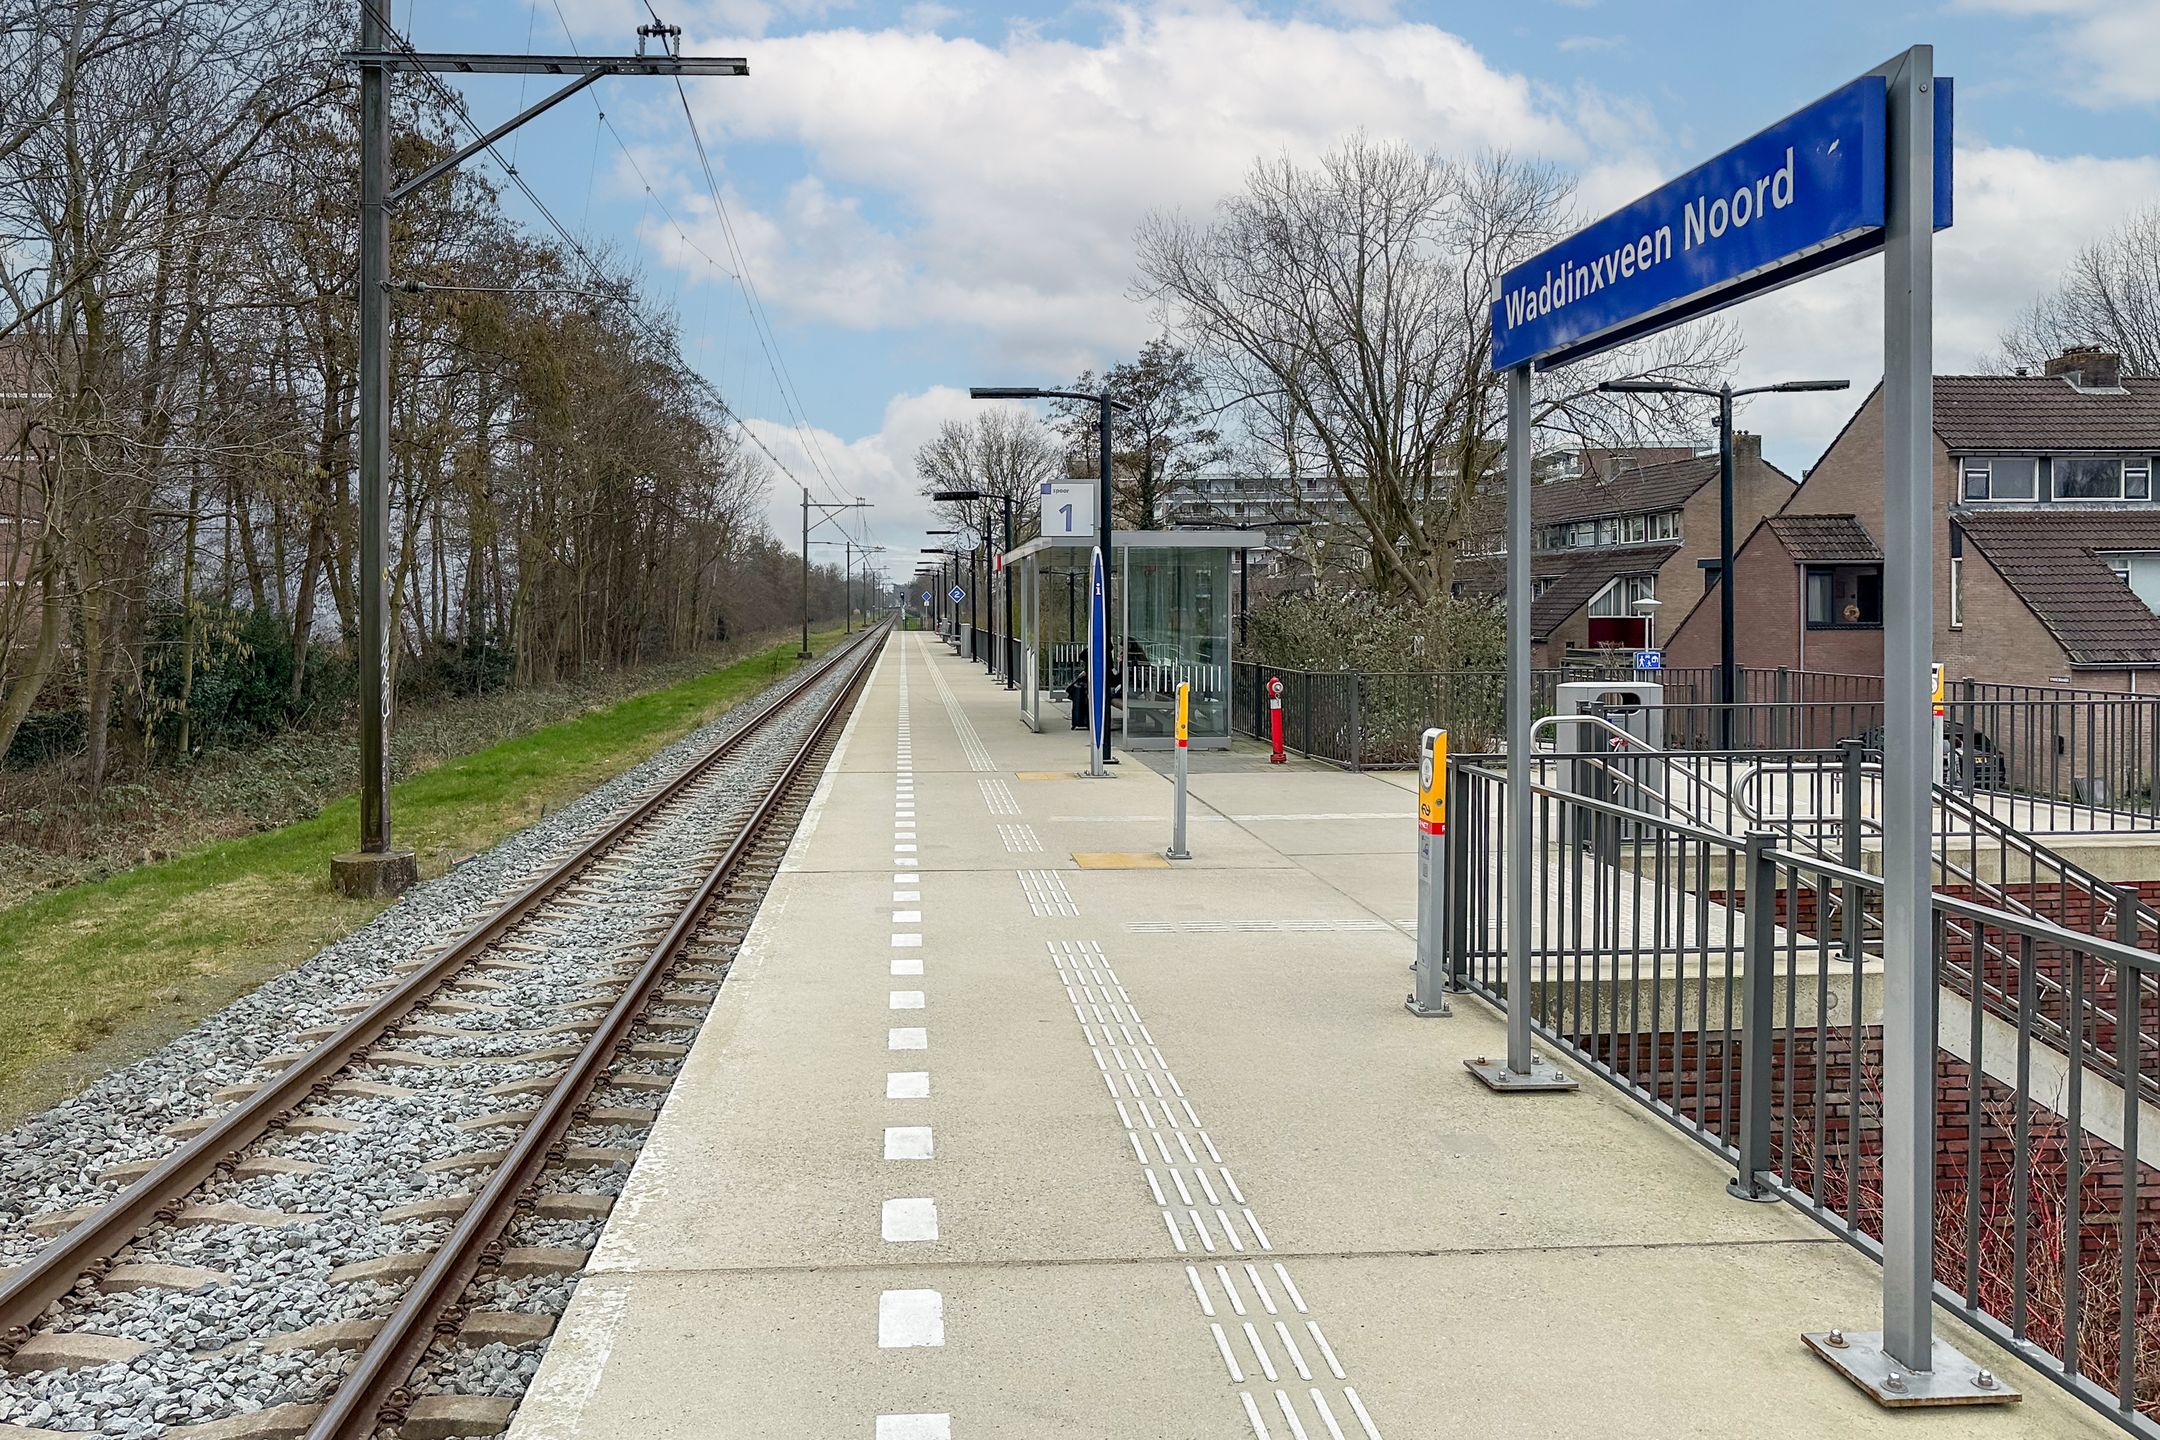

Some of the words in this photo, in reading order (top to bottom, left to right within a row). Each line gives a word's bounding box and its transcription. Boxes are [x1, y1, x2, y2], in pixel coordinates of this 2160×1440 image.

[1505, 225, 1672, 330] Waddinxveen
[1684, 146, 1794, 251] Noord
[1058, 503, 1073, 532] 1
[953, 590, 961, 599] 2
